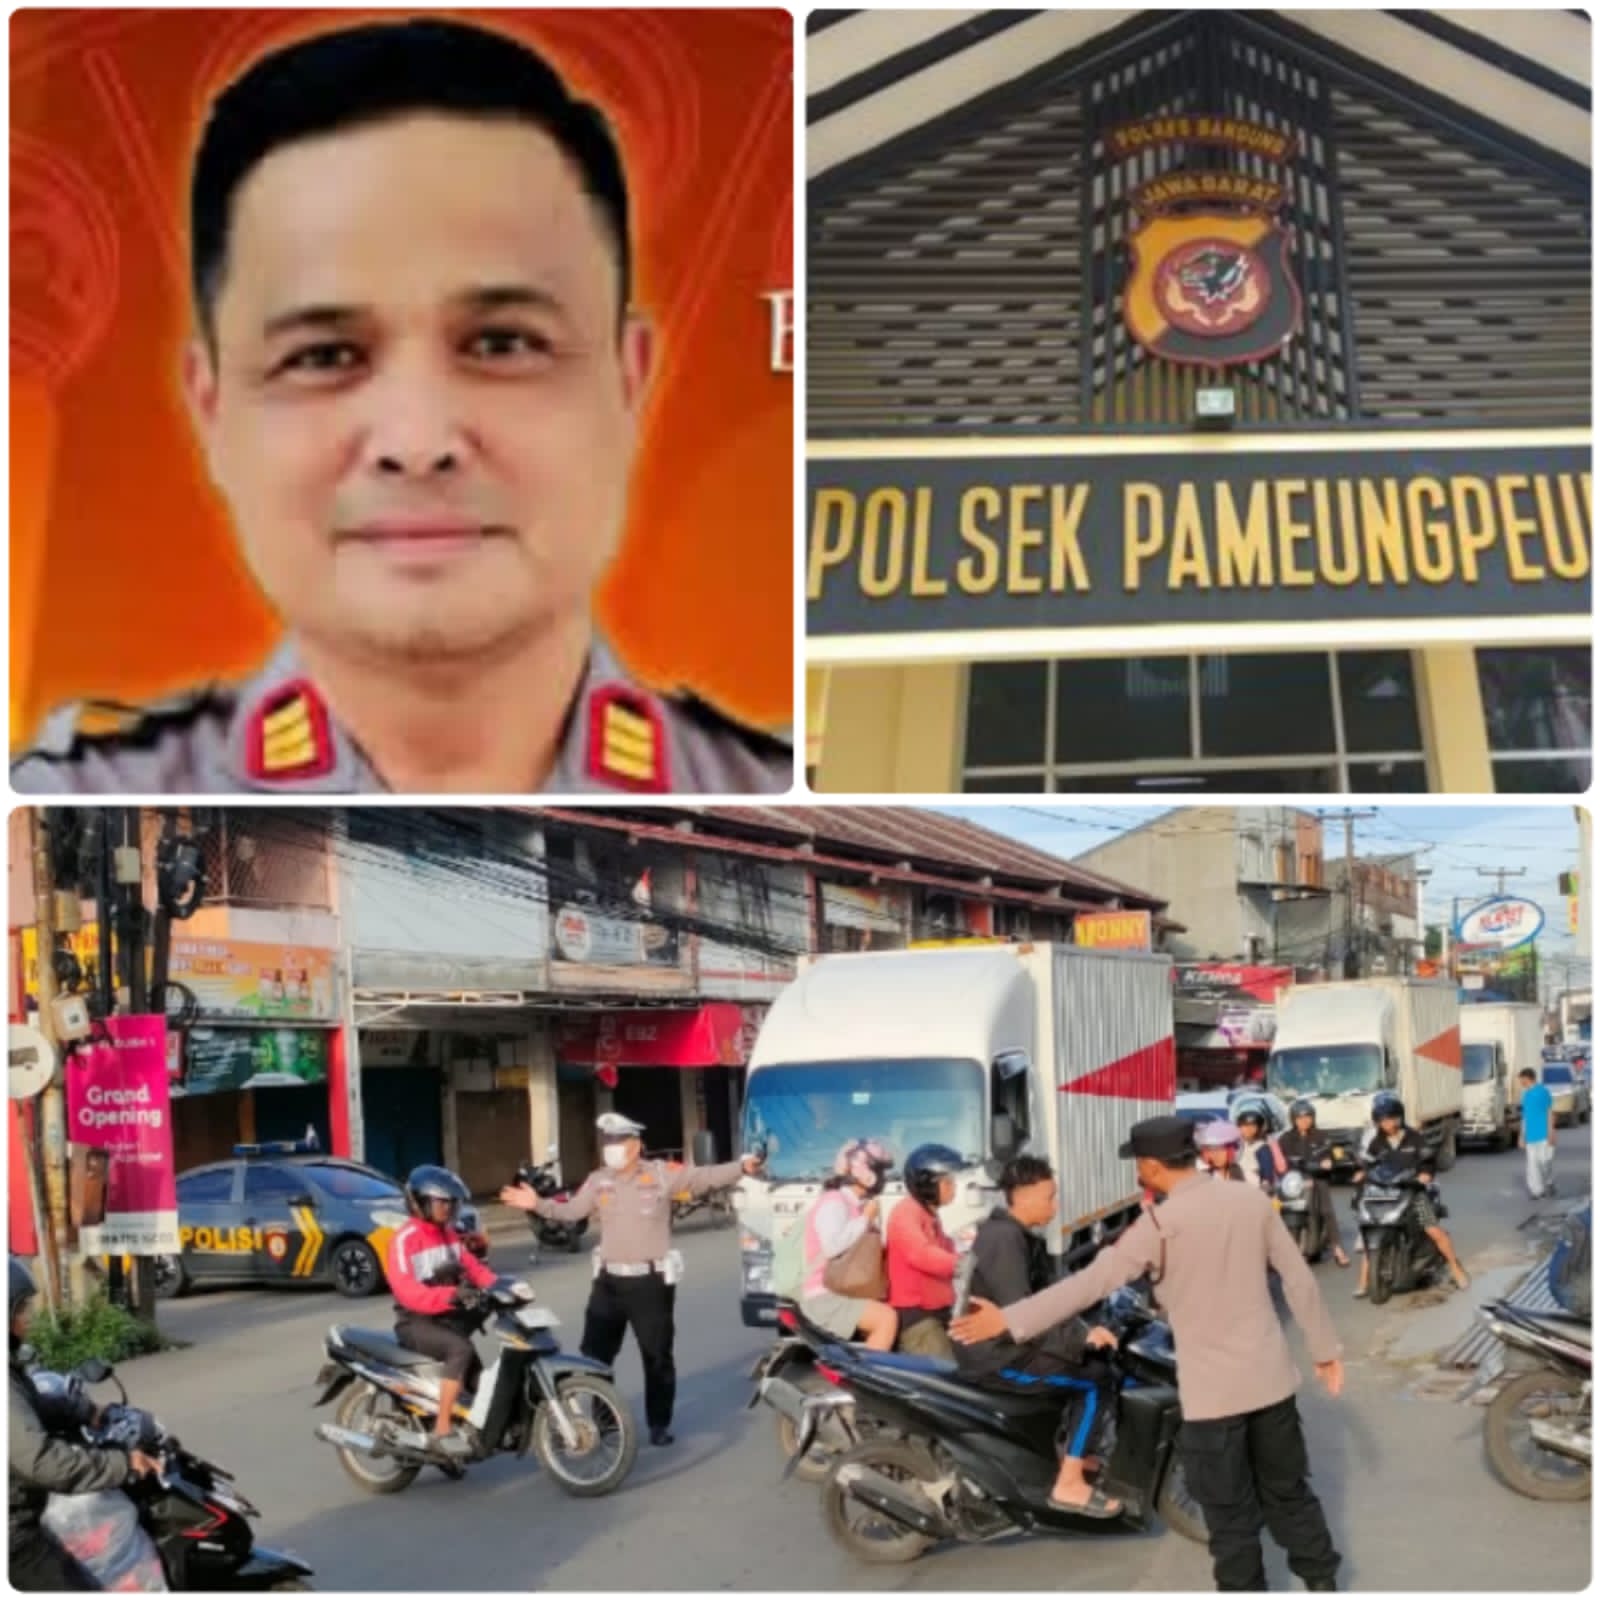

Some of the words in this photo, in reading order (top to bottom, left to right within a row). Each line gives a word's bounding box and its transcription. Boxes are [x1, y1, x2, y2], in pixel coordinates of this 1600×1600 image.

[807, 483, 1091, 600] POLSEK
[86, 1084, 151, 1105] Grand
[78, 1106, 162, 1129] Opening
[178, 1226, 264, 1253] POLISI
